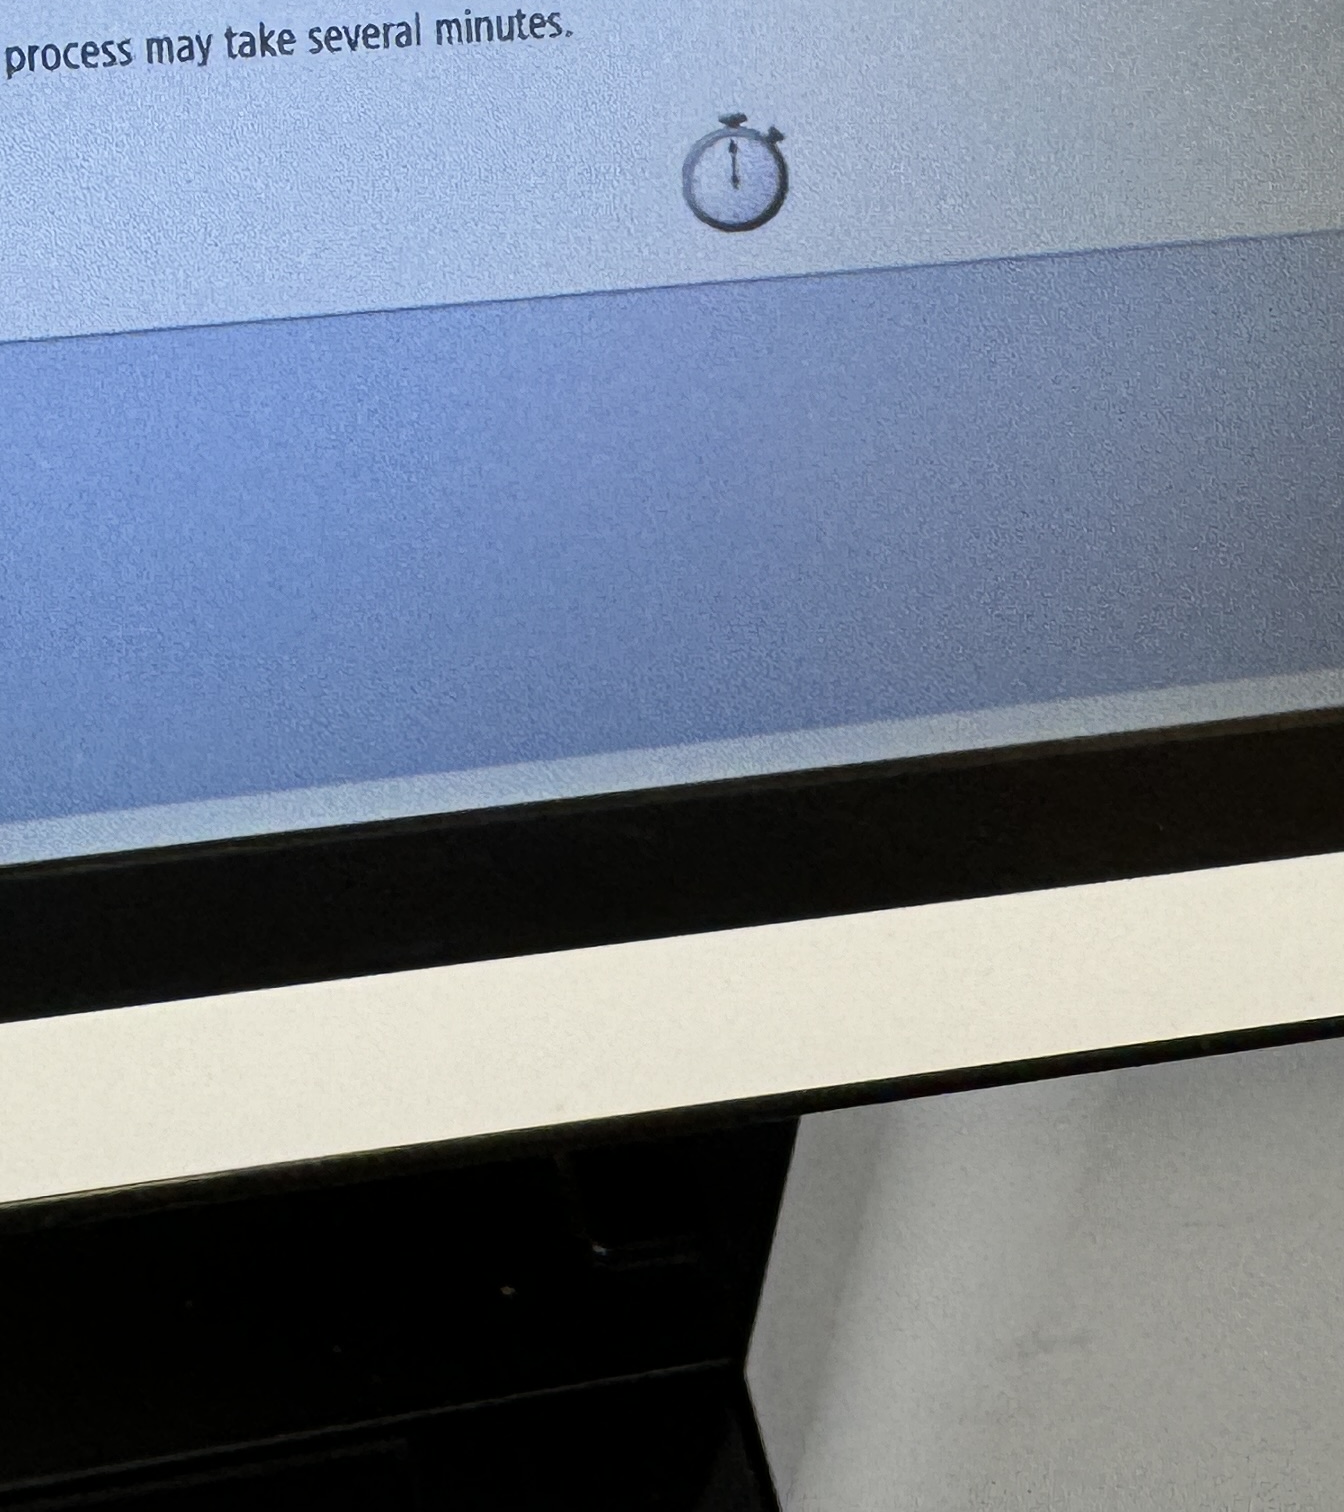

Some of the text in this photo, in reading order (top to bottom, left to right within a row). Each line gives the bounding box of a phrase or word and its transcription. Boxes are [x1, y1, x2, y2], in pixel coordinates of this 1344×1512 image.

[5, 39, 133, 79] process
[147, 34, 212, 67] may
[224, 22, 296, 59] take
[309, 12, 420, 54] several
[436, 9, 573, 45] minutes.
